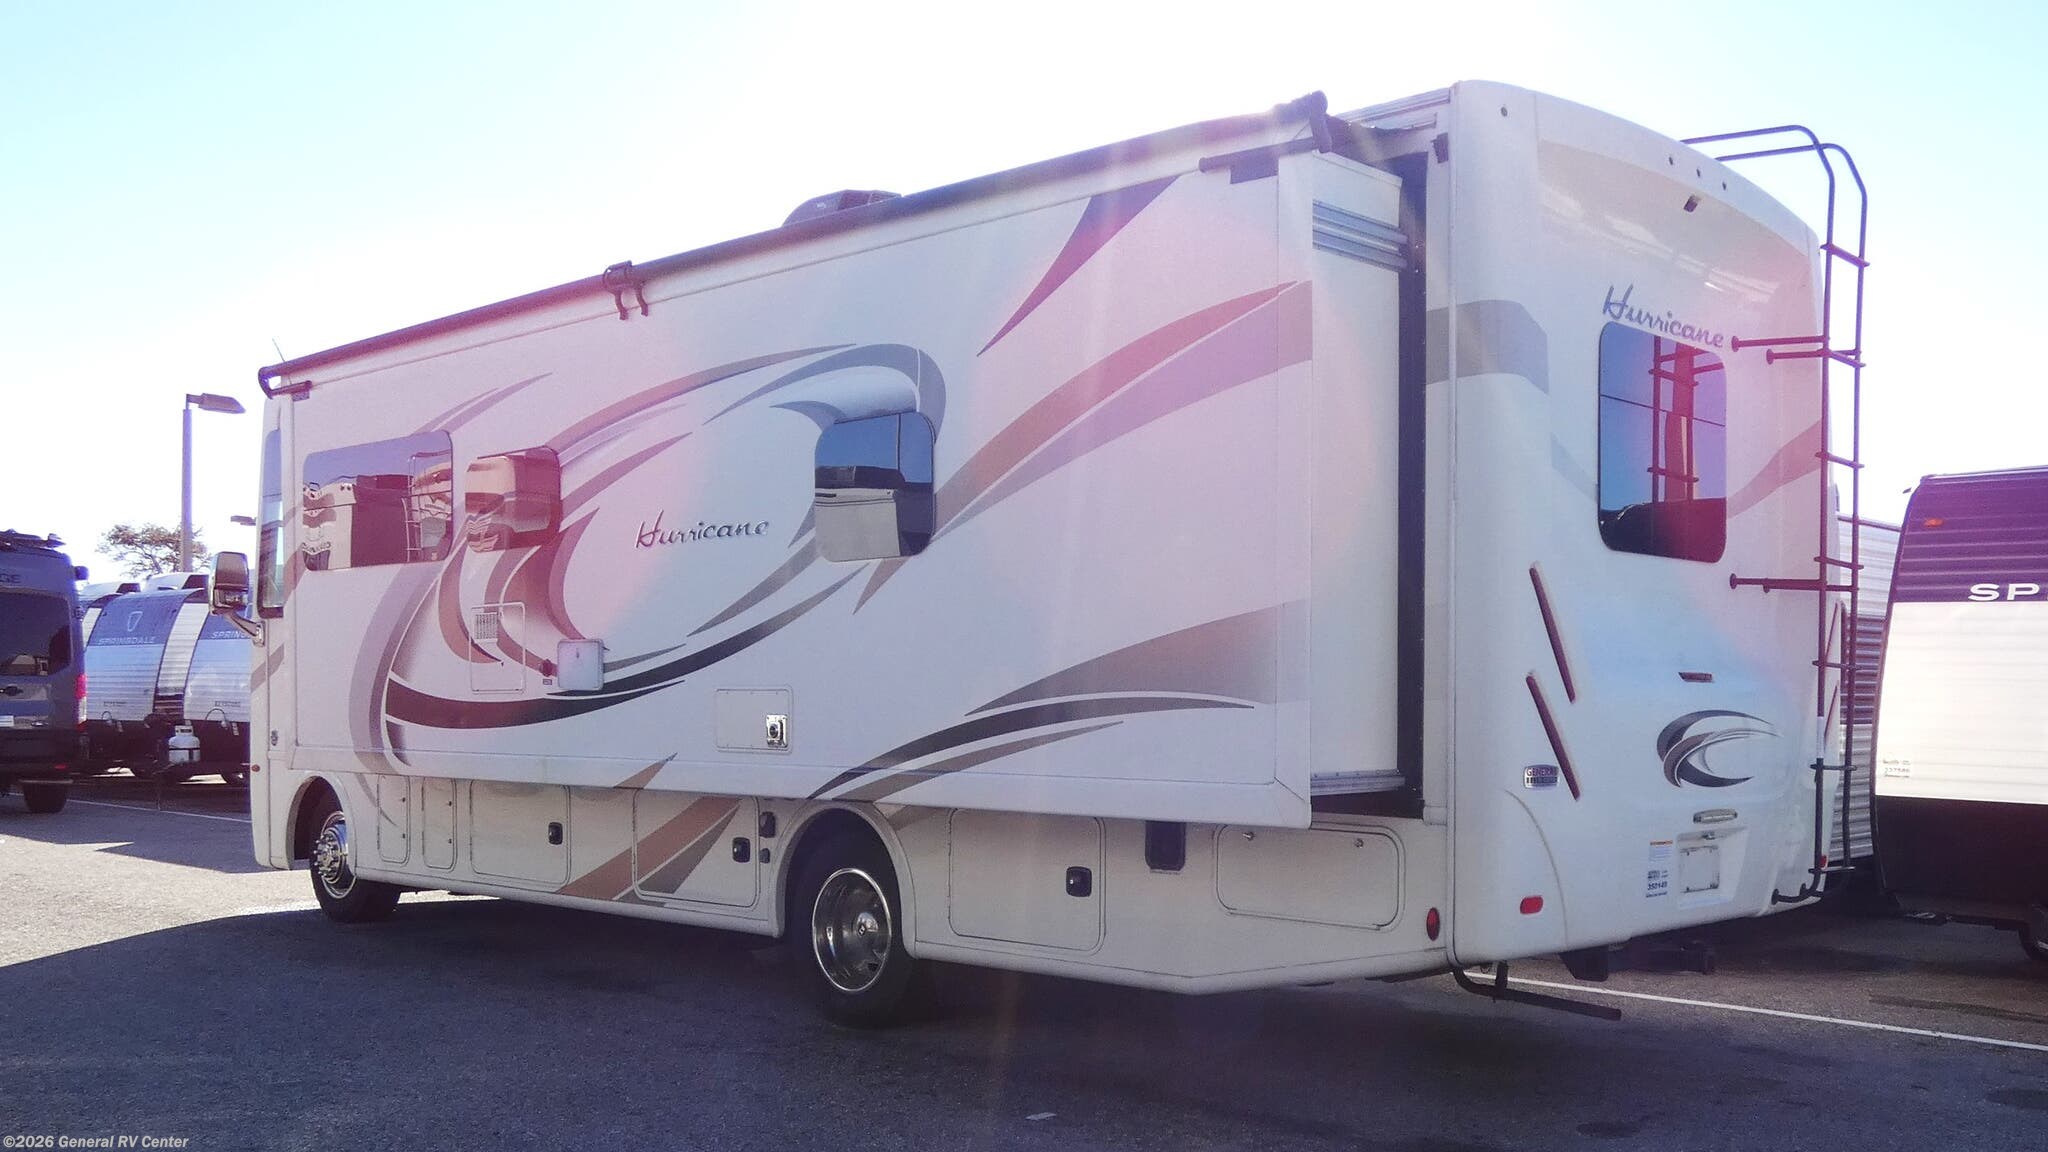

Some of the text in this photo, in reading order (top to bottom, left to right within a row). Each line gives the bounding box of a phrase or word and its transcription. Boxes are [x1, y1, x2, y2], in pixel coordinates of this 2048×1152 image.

[1603, 284, 1724, 348] Hurricane
[635, 509, 769, 548] Hurricane
[1967, 583, 2048, 602] SP
[210, 630, 250, 639] SPRING
